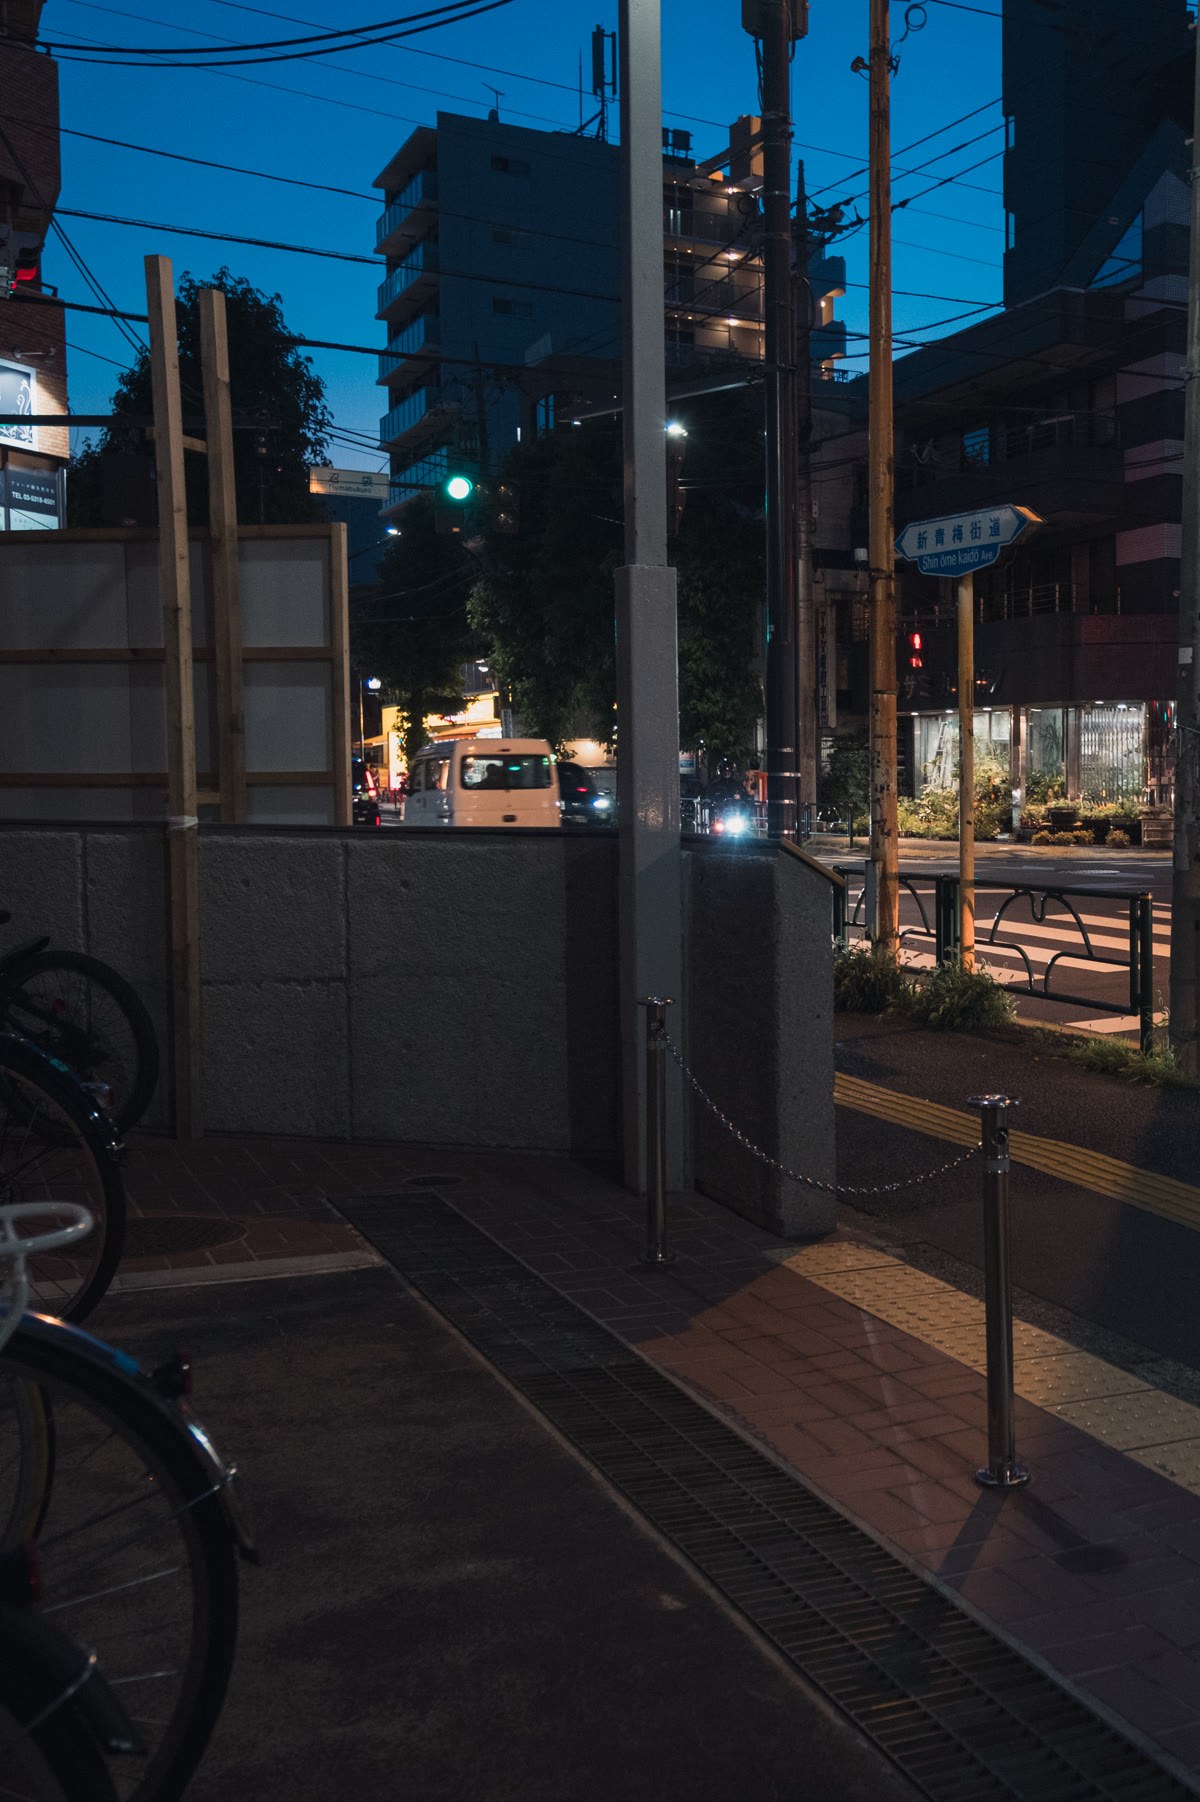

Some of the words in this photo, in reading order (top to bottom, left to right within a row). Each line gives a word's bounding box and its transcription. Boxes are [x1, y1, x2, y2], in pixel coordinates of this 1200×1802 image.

[11, 491, 23, 500] TEL
[917, 516, 1000, 549] 新青梅街道
[922, 555, 939, 570] Shin
[958, 549, 979, 565] kaidō
[981, 550, 994, 561] Ave.
